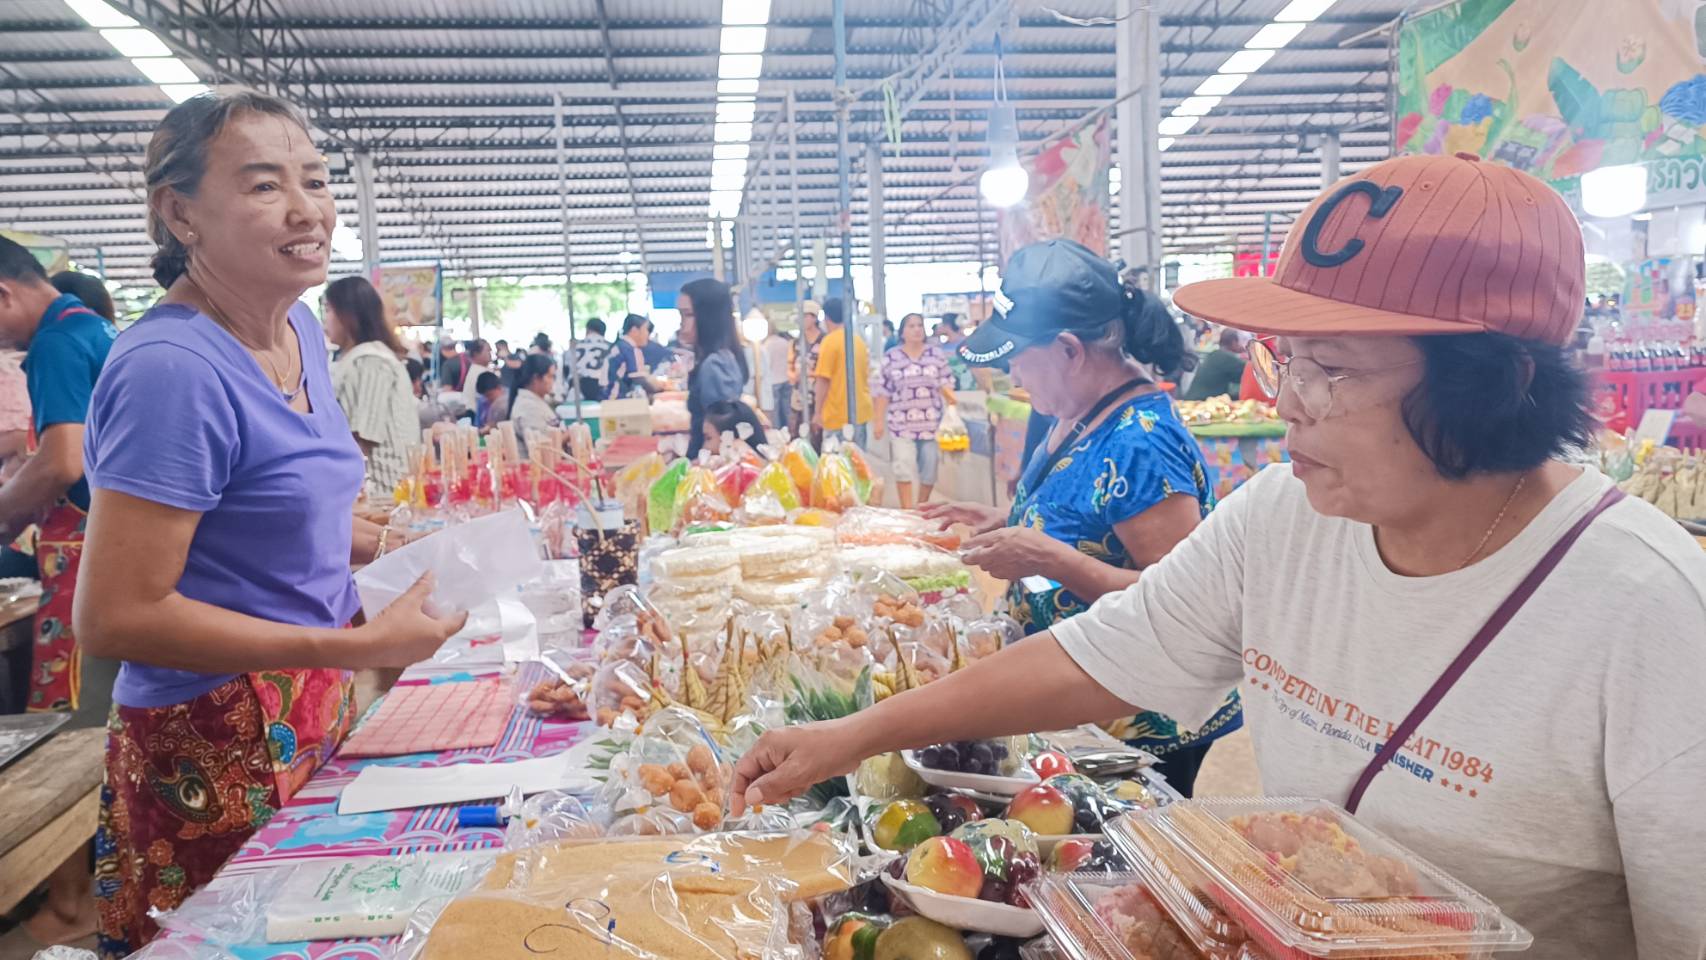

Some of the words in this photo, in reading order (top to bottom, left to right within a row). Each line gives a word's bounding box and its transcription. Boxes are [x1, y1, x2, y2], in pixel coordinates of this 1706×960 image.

[1301, 181, 1404, 268] C
[961, 341, 1014, 362] SWITZERLAND
[1344, 702, 1380, 736] THE
[1440, 747, 1493, 783] 1984
